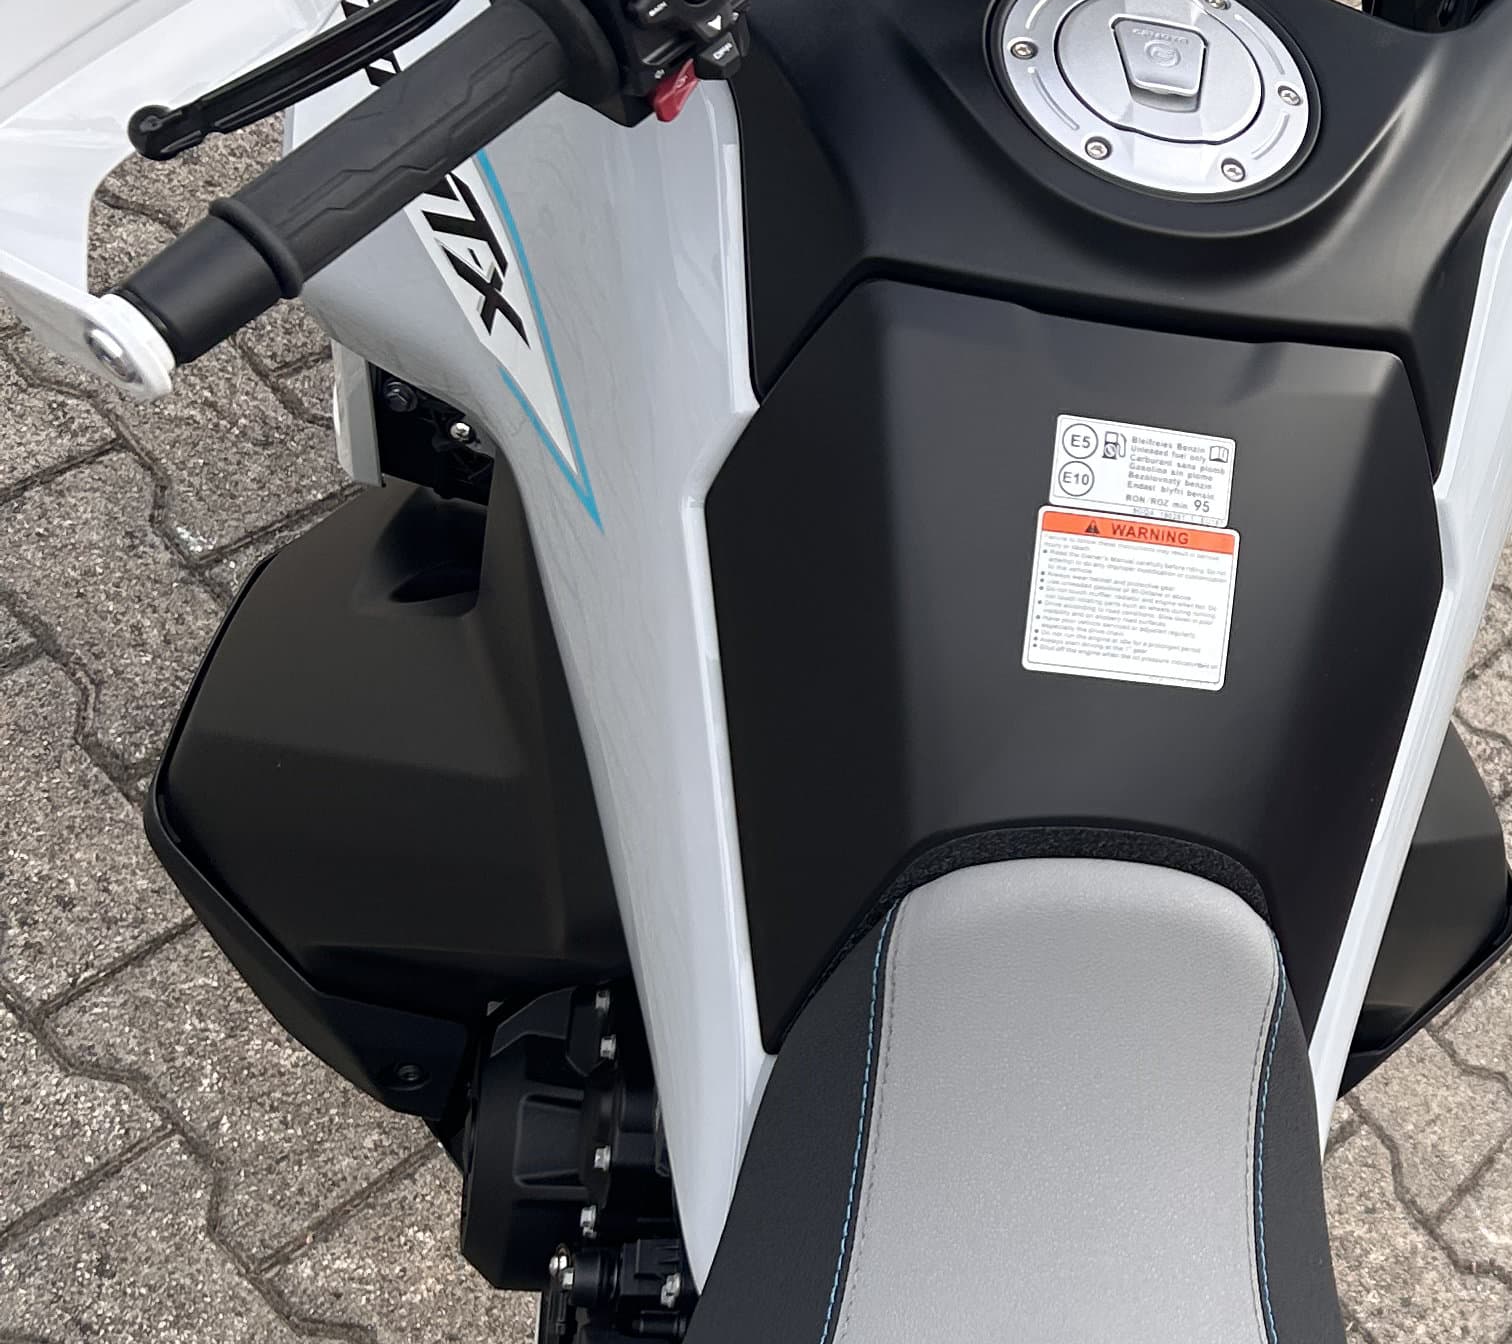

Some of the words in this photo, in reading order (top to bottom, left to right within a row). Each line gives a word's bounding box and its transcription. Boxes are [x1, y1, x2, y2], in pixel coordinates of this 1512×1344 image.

[1070, 434, 1092, 449] E5
[1062, 471, 1090, 486] E10
[1193, 499, 1211, 513] 95
[1112, 523, 1188, 544] WARNING
